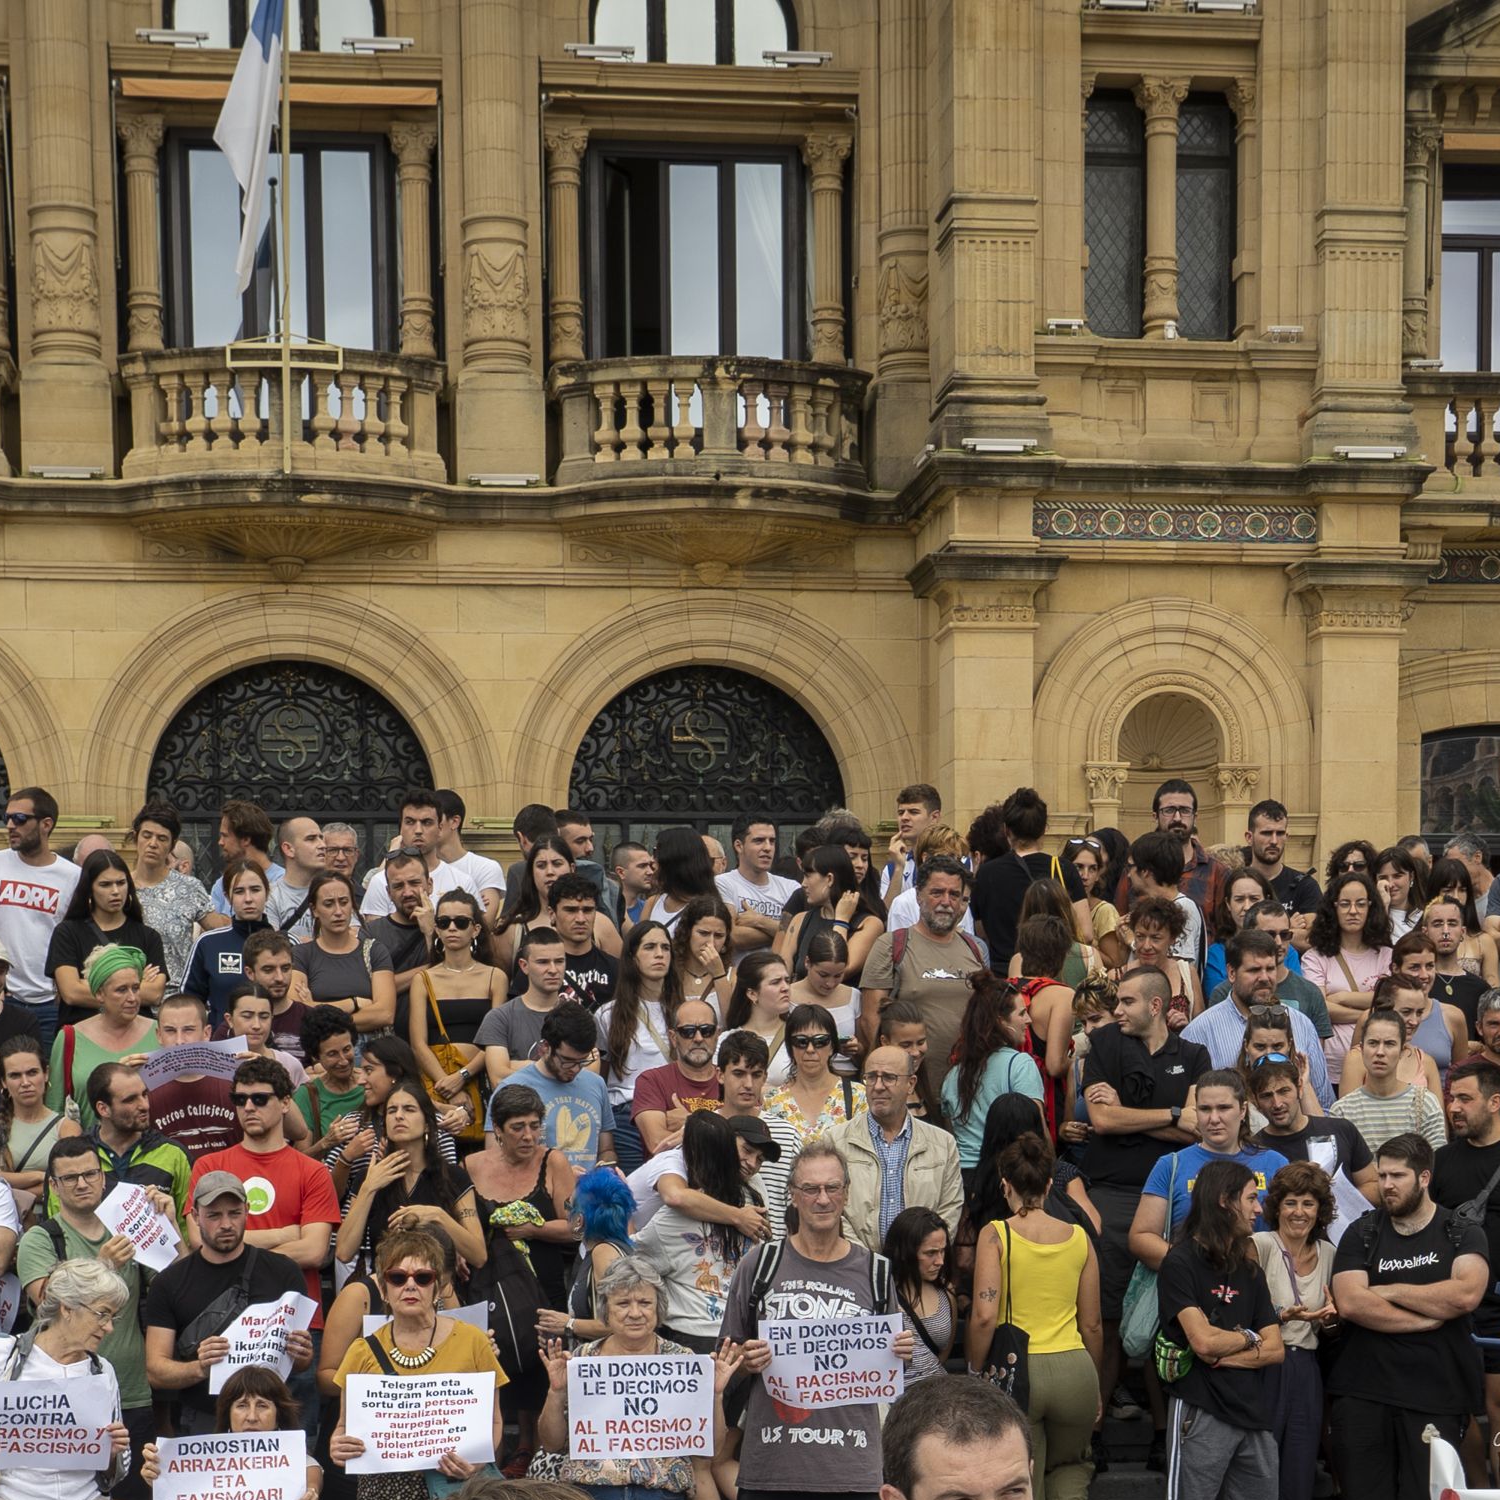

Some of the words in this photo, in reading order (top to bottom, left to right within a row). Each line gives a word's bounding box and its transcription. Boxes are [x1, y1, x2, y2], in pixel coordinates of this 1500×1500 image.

[781, 1280, 804, 1291] THE
[806, 1281, 855, 1300] ROLLING
[769, 1327, 792, 1341] EN
[799, 1321, 892, 1339] DONOSTIA
[774, 1342, 797, 1357] LE
[803, 1337, 887, 1354] DECIMOS
[577, 1363, 601, 1378] EN
[608, 1361, 703, 1378] DONOSTIA
[814, 1353, 848, 1371] NO
[380, 1380, 437, 1391] Telegram
[441, 1379, 461, 1387] eta
[583, 1381, 606, 1396] LE
[613, 1379, 698, 1395] DECIMOS
[768, 1375, 789, 1389] AL
[796, 1370, 881, 1389] RACISMO
[3, 1394, 70, 1411] LUCHA
[366, 1389, 422, 1400] Intagram
[425, 1388, 474, 1397] kontuak
[772, 1388, 793, 1402] AL
[800, 1385, 895, 1404] FASCISMO
[361, 1401, 394, 1409] sortu
[397, 1401, 421, 1409] dira
[424, 1398, 478, 1409] pertsona
[624, 1397, 659, 1416] NO
[375, 1409, 465, 1419] arrazializatuen
[389, 1418, 450, 1430] aurpegiak
[574, 1420, 598, 1435] AL
[605, 1418, 692, 1434] RACISMO
[371, 1429, 444, 1441] argitaratzen
[448, 1426, 467, 1434] eta
[761, 1425, 783, 1444] U.S.
[788, 1427, 844, 1446] TOUR
[178, 1438, 280, 1456] DONOSTIAN
[376, 1436, 461, 1449] biolentziarako
[577, 1438, 602, 1453] AL
[608, 1435, 706, 1452] FASCISMO
[381, 1450, 415, 1460] deiak
[418, 1446, 457, 1458] eginez
[168, 1454, 290, 1473] ARRAZAKERIA
[213, 1474, 246, 1489] ETA
